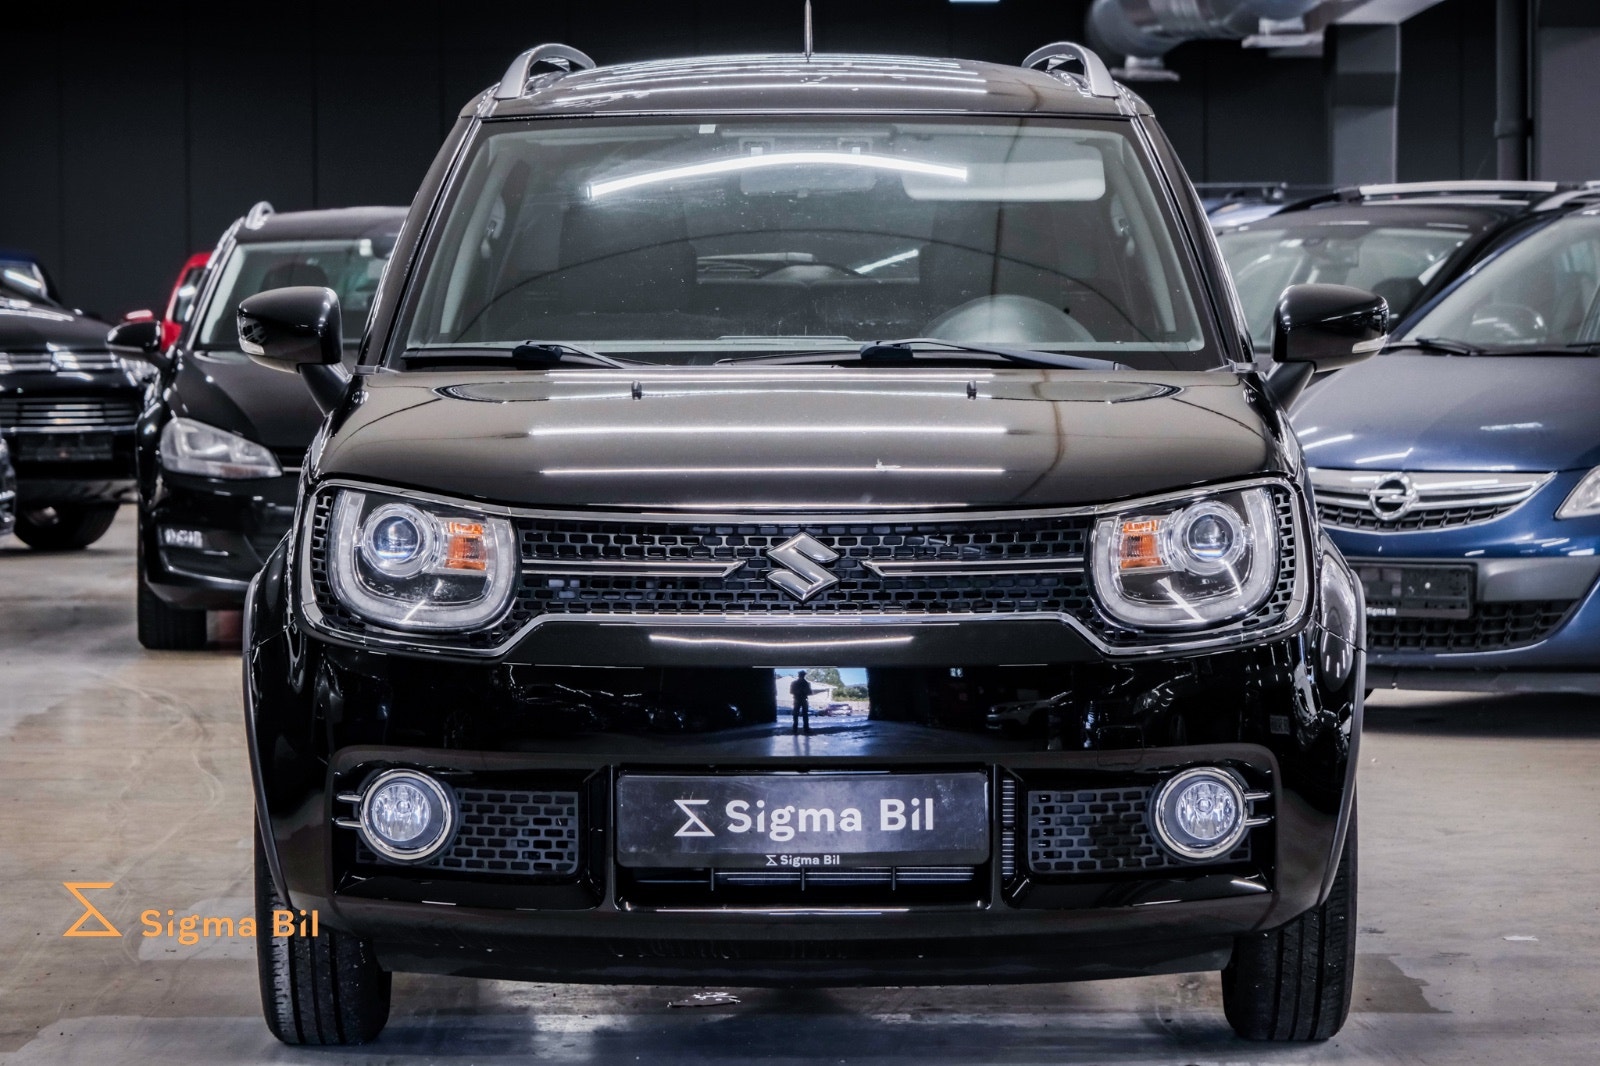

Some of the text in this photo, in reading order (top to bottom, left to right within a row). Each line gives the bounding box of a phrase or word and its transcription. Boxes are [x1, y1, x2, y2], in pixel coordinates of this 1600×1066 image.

[725, 797, 934, 842] Sigma Bil
[780, 854, 840, 868] Sigma Bil
